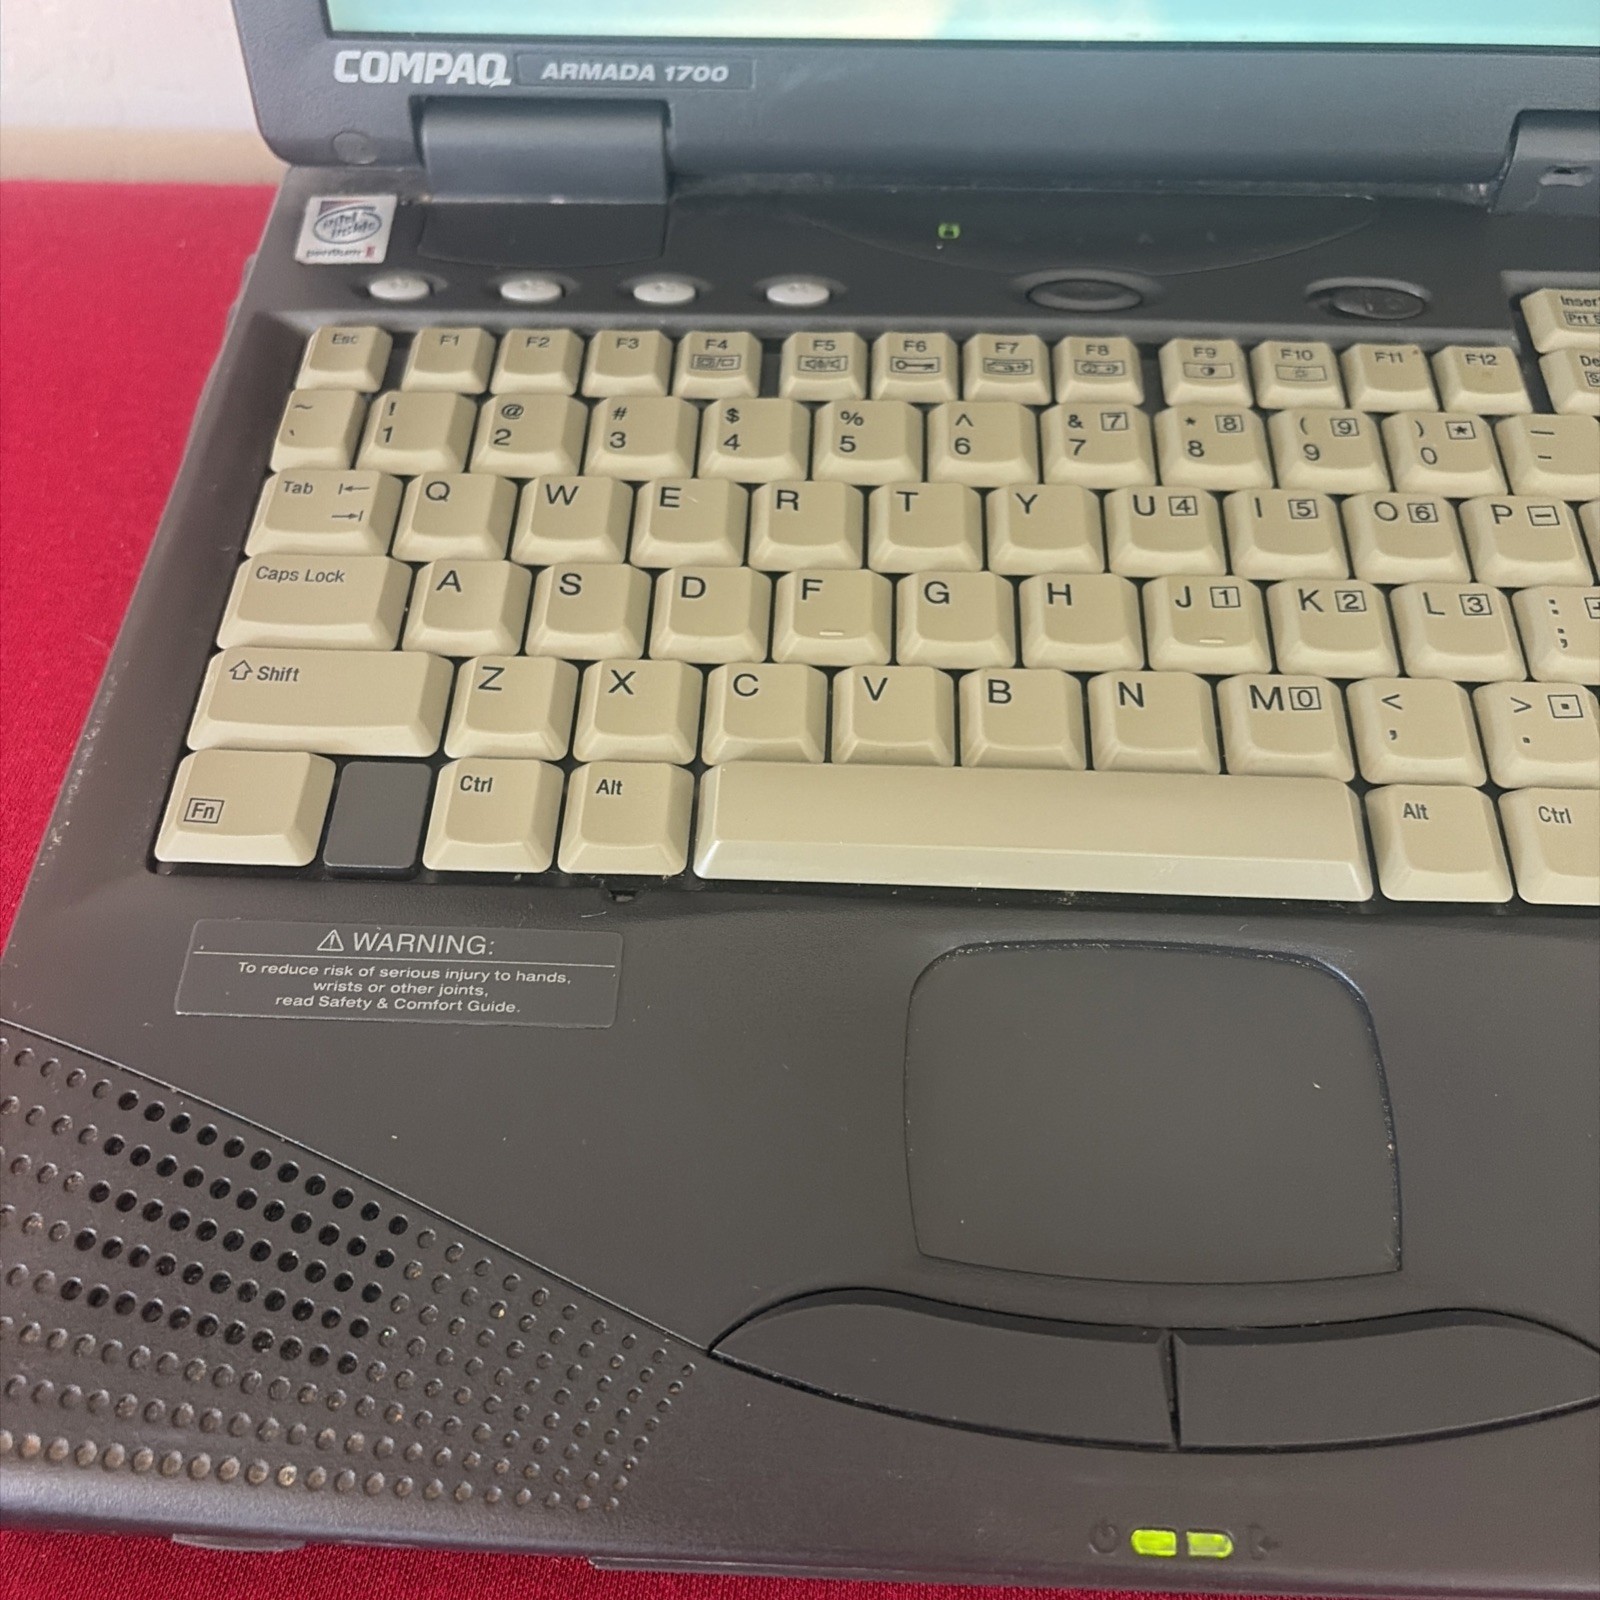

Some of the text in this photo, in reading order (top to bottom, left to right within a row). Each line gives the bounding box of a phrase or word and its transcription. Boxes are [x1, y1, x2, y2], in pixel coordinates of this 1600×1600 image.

[334, 50, 511, 87] COMPAQ
[541, 62, 729, 83] ARMADA 1700
[1560, 295, 1600, 307] Inser
[332, 333, 359, 346] Esc
[440, 334, 459, 345] F1
[526, 336, 550, 347] F2
[616, 337, 639, 349] F3
[705, 339, 727, 349] F4
[813, 339, 835, 351] F5
[904, 340, 926, 352] F6
[995, 342, 1019, 354] F7
[1086, 344, 1109, 356] F8
[1193, 346, 1216, 358] F9
[1281, 348, 1313, 361] F10
[1375, 352, 1403, 362] F11
[1465, 354, 1497, 365] F12
[501, 404, 524, 419] @
[614, 407, 626, 420] #
[726, 408, 739, 423] $
[840, 411, 864, 426] %
[1068, 414, 1123, 428] & 7
[1222, 415, 1238, 431] 8
[1300, 417, 1352, 435] ( 9
[1415, 421, 1424, 437] )
[384, 427, 392, 442] 1
[494, 429, 511, 445] 2
[610, 432, 626, 448] 3
[724, 434, 740, 450] 4
[840, 435, 856, 452] 5
[955, 437, 971, 455] 6
[1069, 439, 1086, 455] 7
[1188, 440, 1204, 457] 8
[1303, 444, 1320, 461] 9
[1421, 447, 1438, 465] 0
[284, 481, 313, 494] Tab
[426, 481, 450, 501] Q
[546, 484, 578, 505] W
[660, 487, 681, 507] E
[777, 490, 798, 511] R
[897, 491, 918, 511] T
[1016, 493, 1037, 514] Y
[1133, 495, 1192, 516] U 4
[1255, 498, 1312, 517] I 5
[1374, 501, 1431, 521] O 6
[1491, 504, 1512, 524] P
[256, 566, 345, 583] Caps Lock
[436, 570, 461, 592] A
[560, 573, 581, 595] S
[681, 576, 706, 598] D
[802, 579, 823, 600] F
[924, 581, 949, 604] G
[1047, 583, 1071, 605] H
[1175, 586, 1229, 608] J 1
[1298, 589, 1360, 612] K 2
[1423, 592, 1485, 615] L 3
[257, 666, 299, 681] Shift
[478, 666, 504, 691] Z
[609, 670, 635, 694] X
[733, 674, 758, 696] C
[863, 676, 887, 701] V
[988, 679, 1011, 704] B
[1118, 682, 1144, 707] N
[1250, 685, 1313, 711] M 0
[1382, 694, 1402, 709] <
[1511, 697, 1532, 713] >
[460, 775, 493, 792] Ctrl
[596, 779, 622, 795] Alt
[191, 802, 214, 819] Fn
[1404, 803, 1429, 820] Alt
[1539, 806, 1571, 823] Ctrl
[353, 931, 495, 955] WARNING:
[238, 961, 572, 985] To reduce risk of serious injury to hands,
[313, 979, 489, 999] wrists or other joints,
[275, 996, 521, 1014] read Safety & Comfort Guide.
